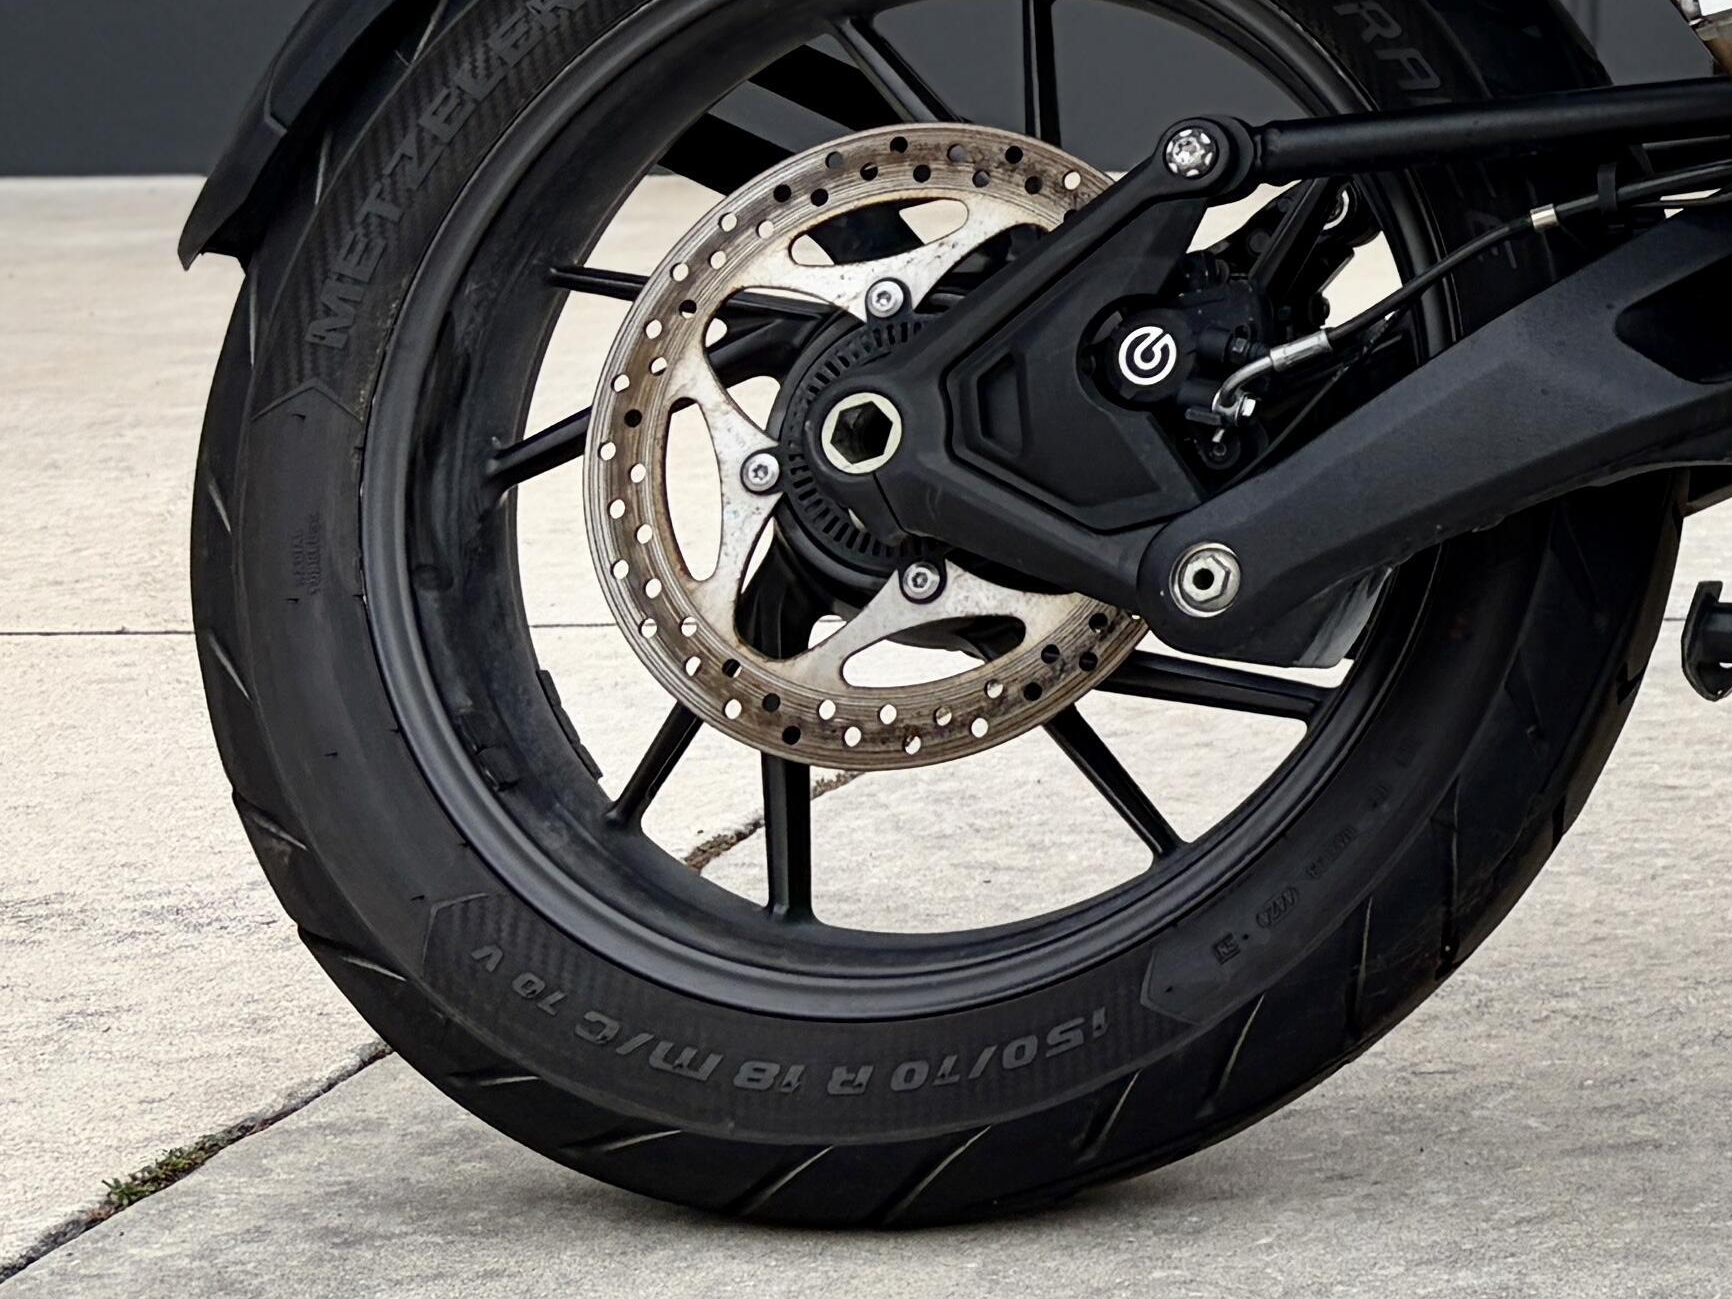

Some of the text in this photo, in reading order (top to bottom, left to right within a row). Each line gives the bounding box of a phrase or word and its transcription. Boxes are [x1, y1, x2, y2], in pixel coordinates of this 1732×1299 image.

[511, 971, 569, 1016] 70
[573, 1010, 725, 1082] M/C
[889, 1005, 1109, 1091] 150/70
[826, 1063, 873, 1096] R
